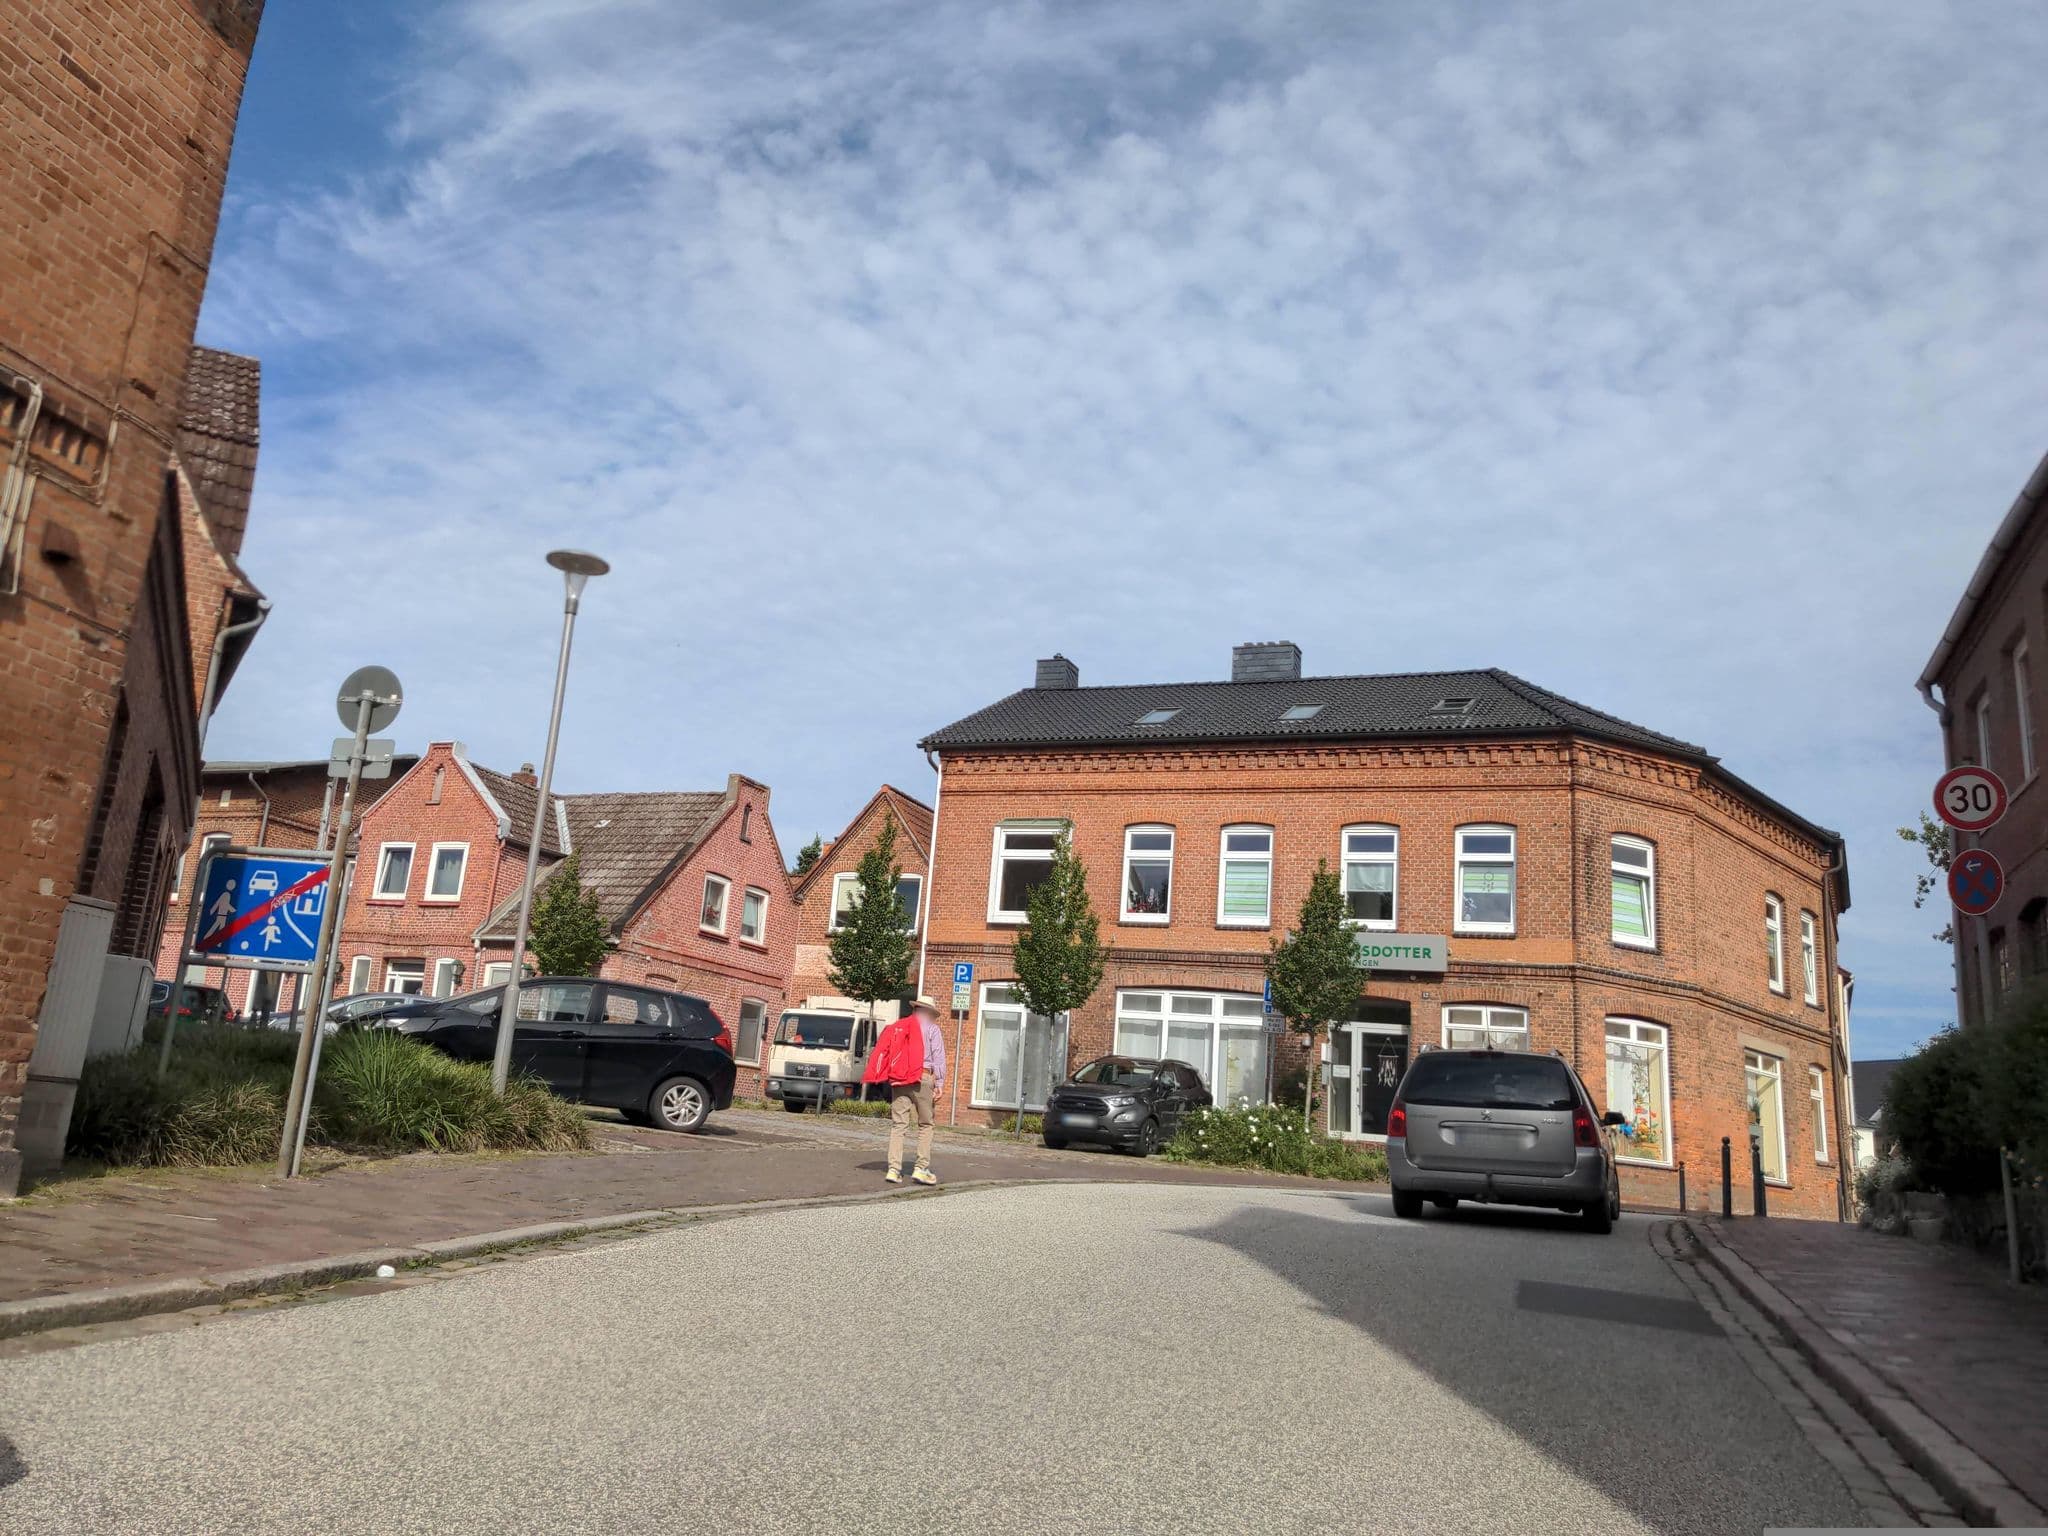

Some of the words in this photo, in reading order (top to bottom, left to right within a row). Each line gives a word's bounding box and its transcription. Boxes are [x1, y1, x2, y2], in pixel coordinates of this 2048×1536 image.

[1949, 784, 1992, 813] 30
[1358, 945, 1432, 959] SDOTTER
[1355, 959, 1379, 967] NGEN
[956, 965, 968, 981] P
